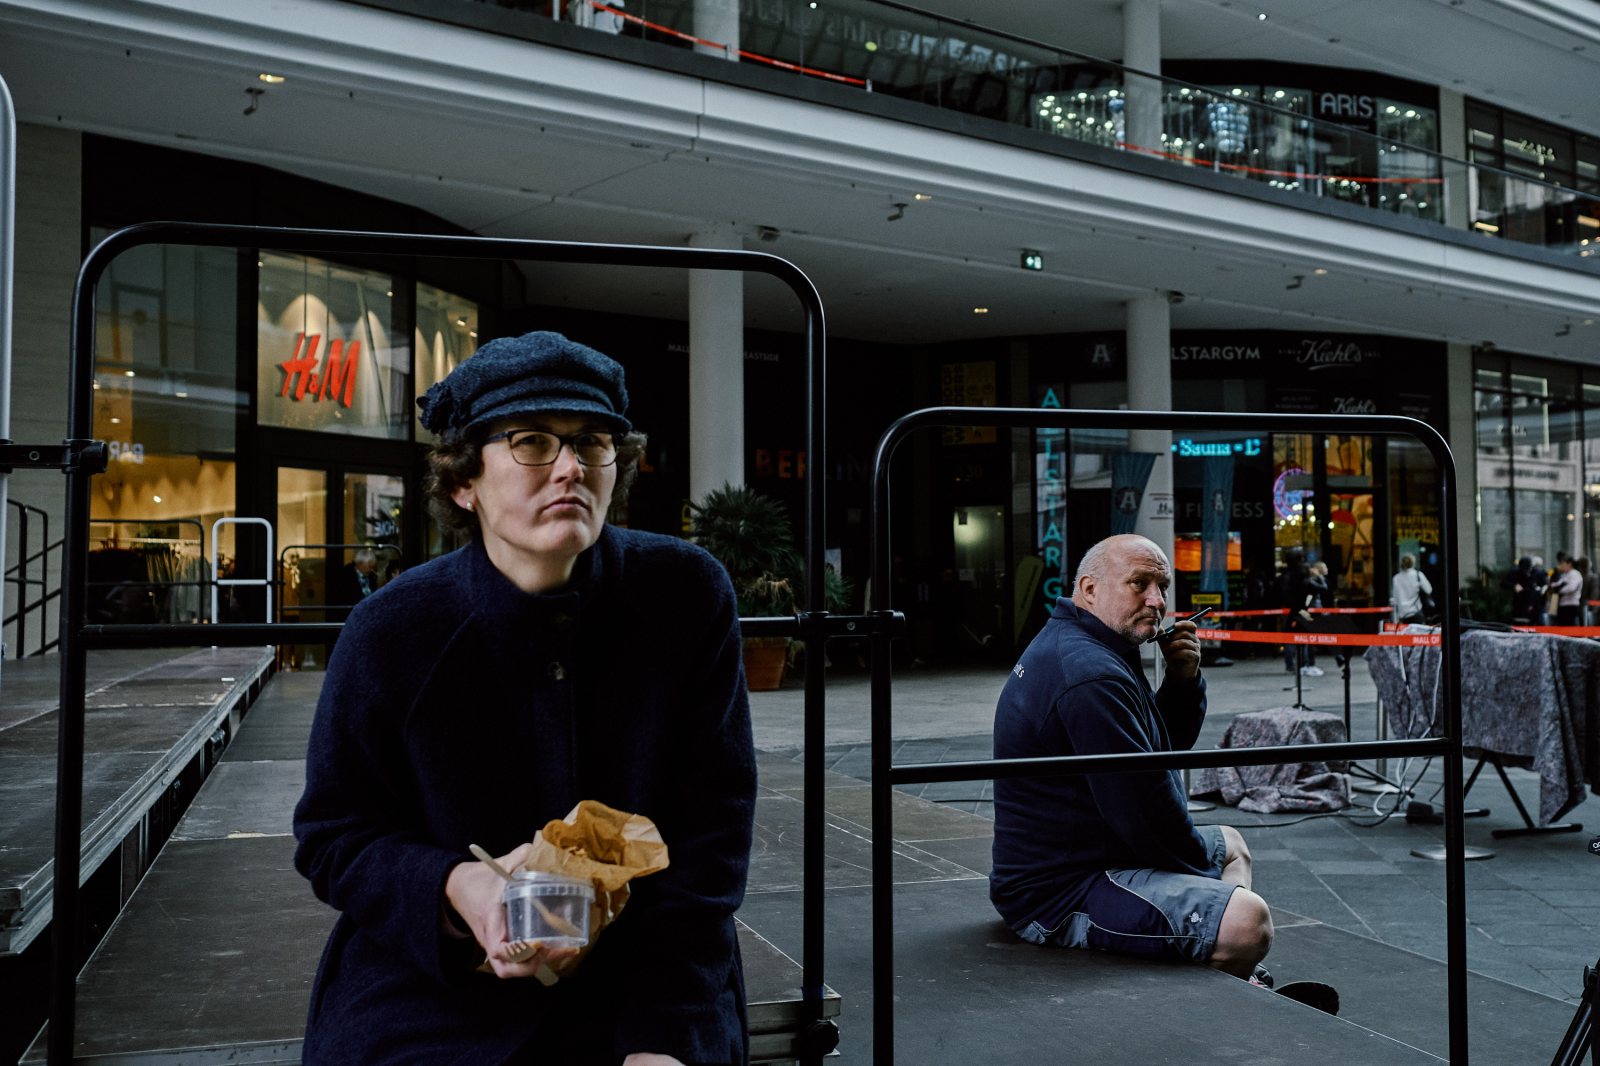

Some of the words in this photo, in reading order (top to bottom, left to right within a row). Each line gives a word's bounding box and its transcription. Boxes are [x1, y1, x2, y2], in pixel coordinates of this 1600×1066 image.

[1320, 92, 1375, 119] ARIS
[1171, 345, 1261, 361] LSTARGYM
[1296, 339, 1362, 364] Kiehl's
[277, 331, 361, 409] H&M
[1179, 439, 1232, 456] Sauna
[1185, 501, 1265, 518] FIESS
[1294, 634, 1308, 643] MALL
[1309, 635, 1318, 643] OF
[1318, 635, 1337, 644] BERLIN
[1412, 636, 1430, 645] MALL
